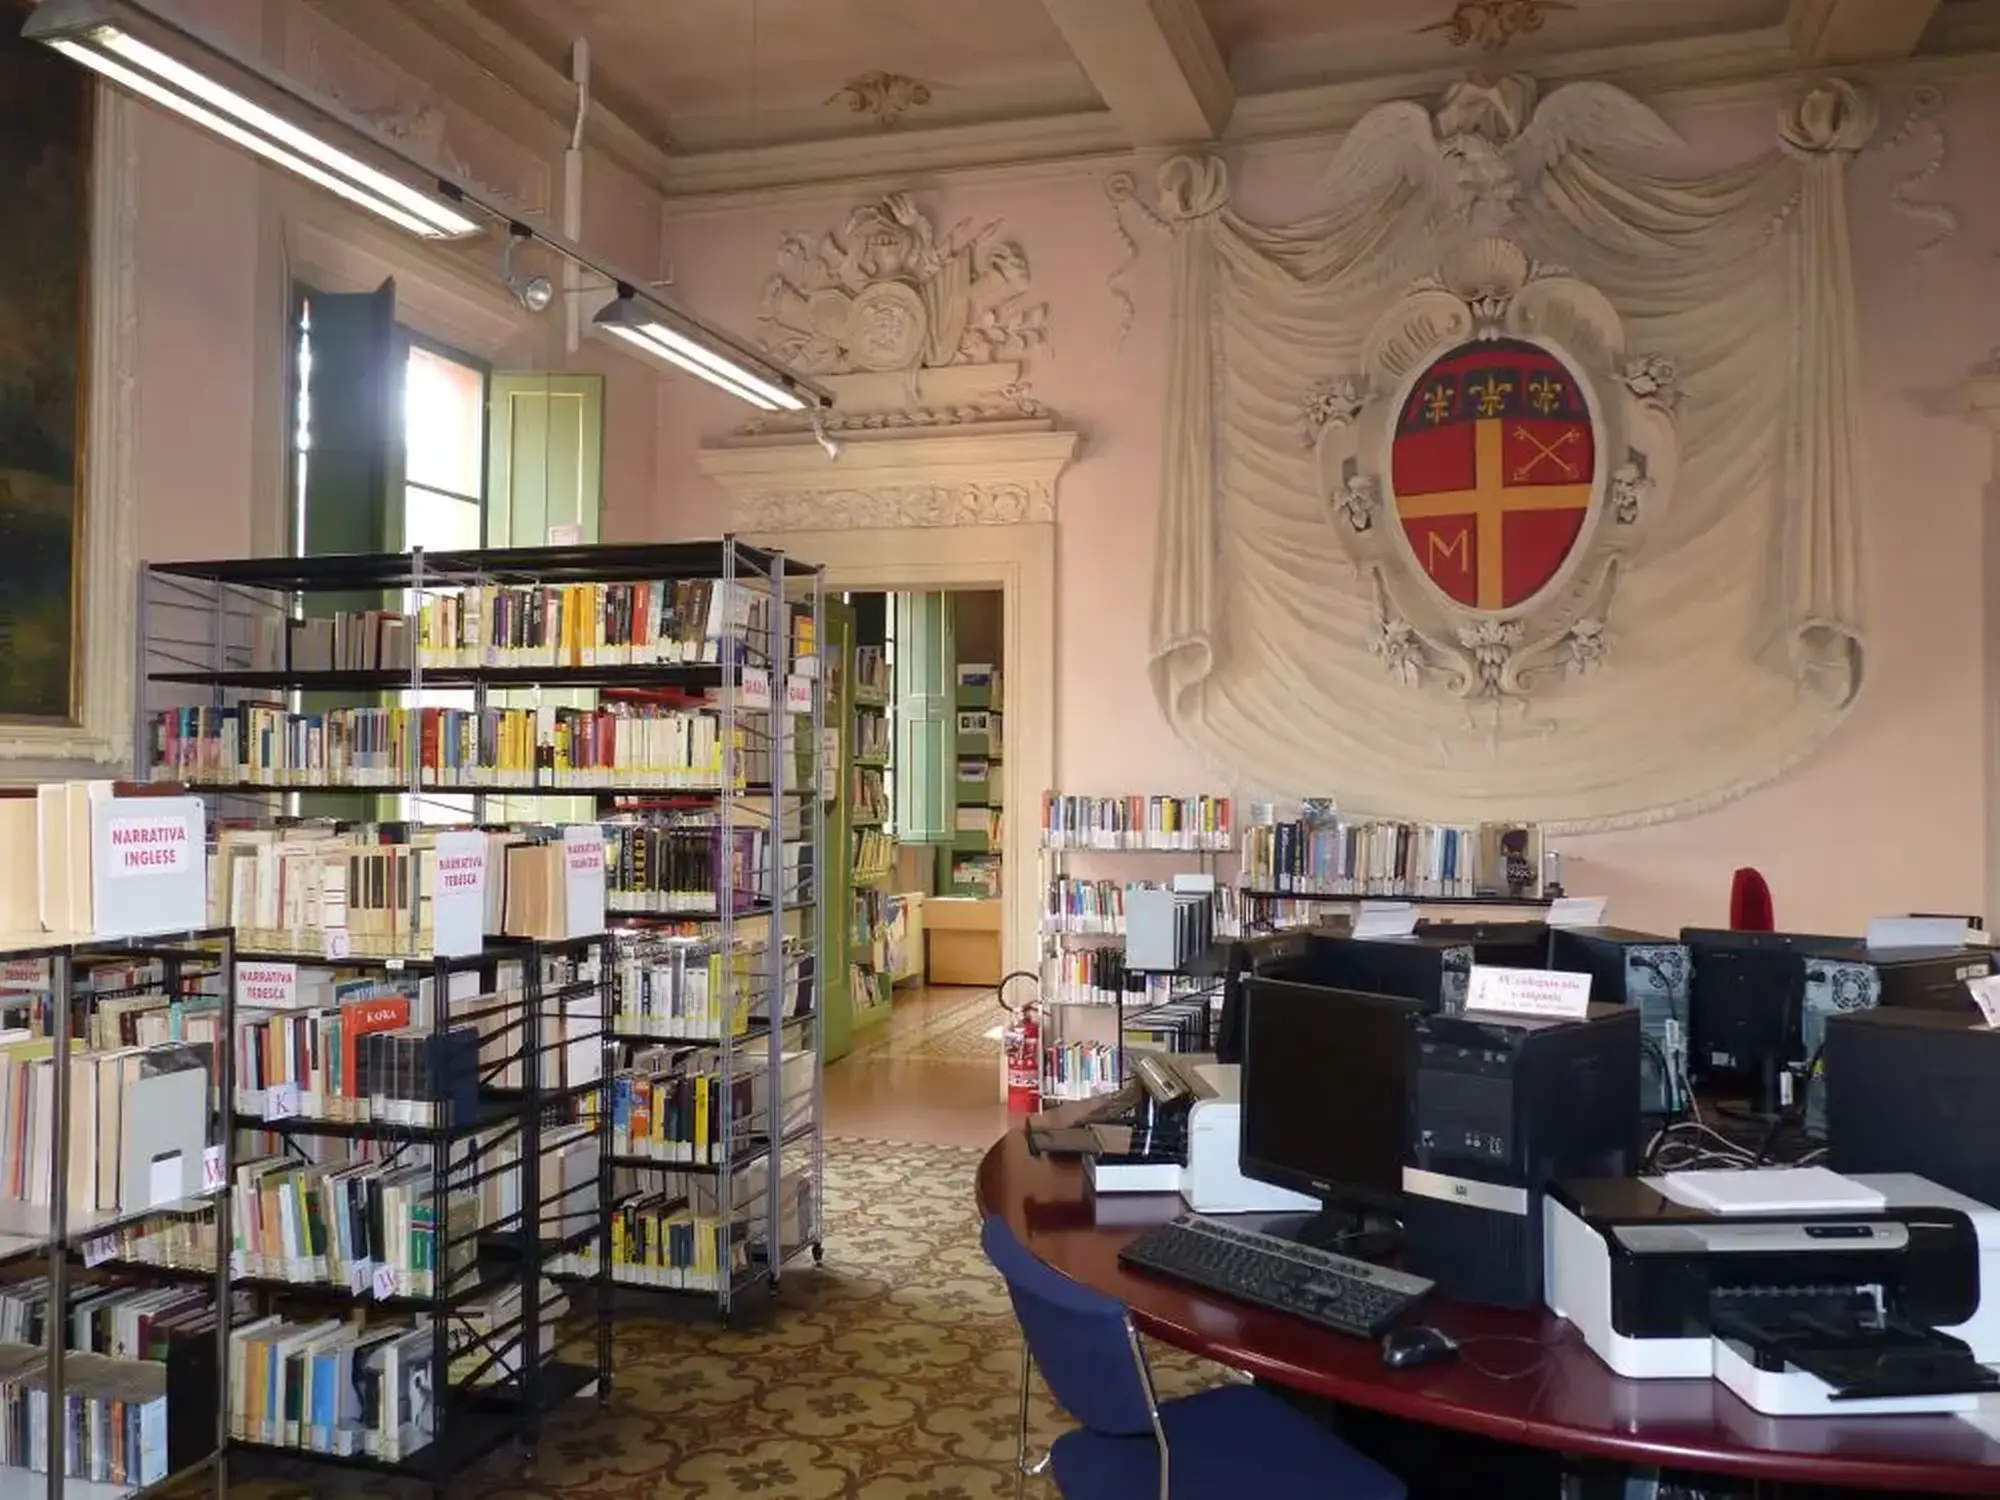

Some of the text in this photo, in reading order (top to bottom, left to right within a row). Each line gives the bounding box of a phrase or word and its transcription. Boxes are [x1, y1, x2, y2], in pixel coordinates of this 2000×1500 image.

[1427, 528, 1469, 574] M
[112, 825, 186, 845] NARRATIVA
[124, 849, 177, 868] INGLESE
[439, 856, 483, 870] NARRATIVA
[444, 873, 478, 887] TEDESCA
[240, 970, 294, 984] NARRATIVA
[247, 986, 286, 1000] TEDESCA
[276, 1091, 289, 1114] K
